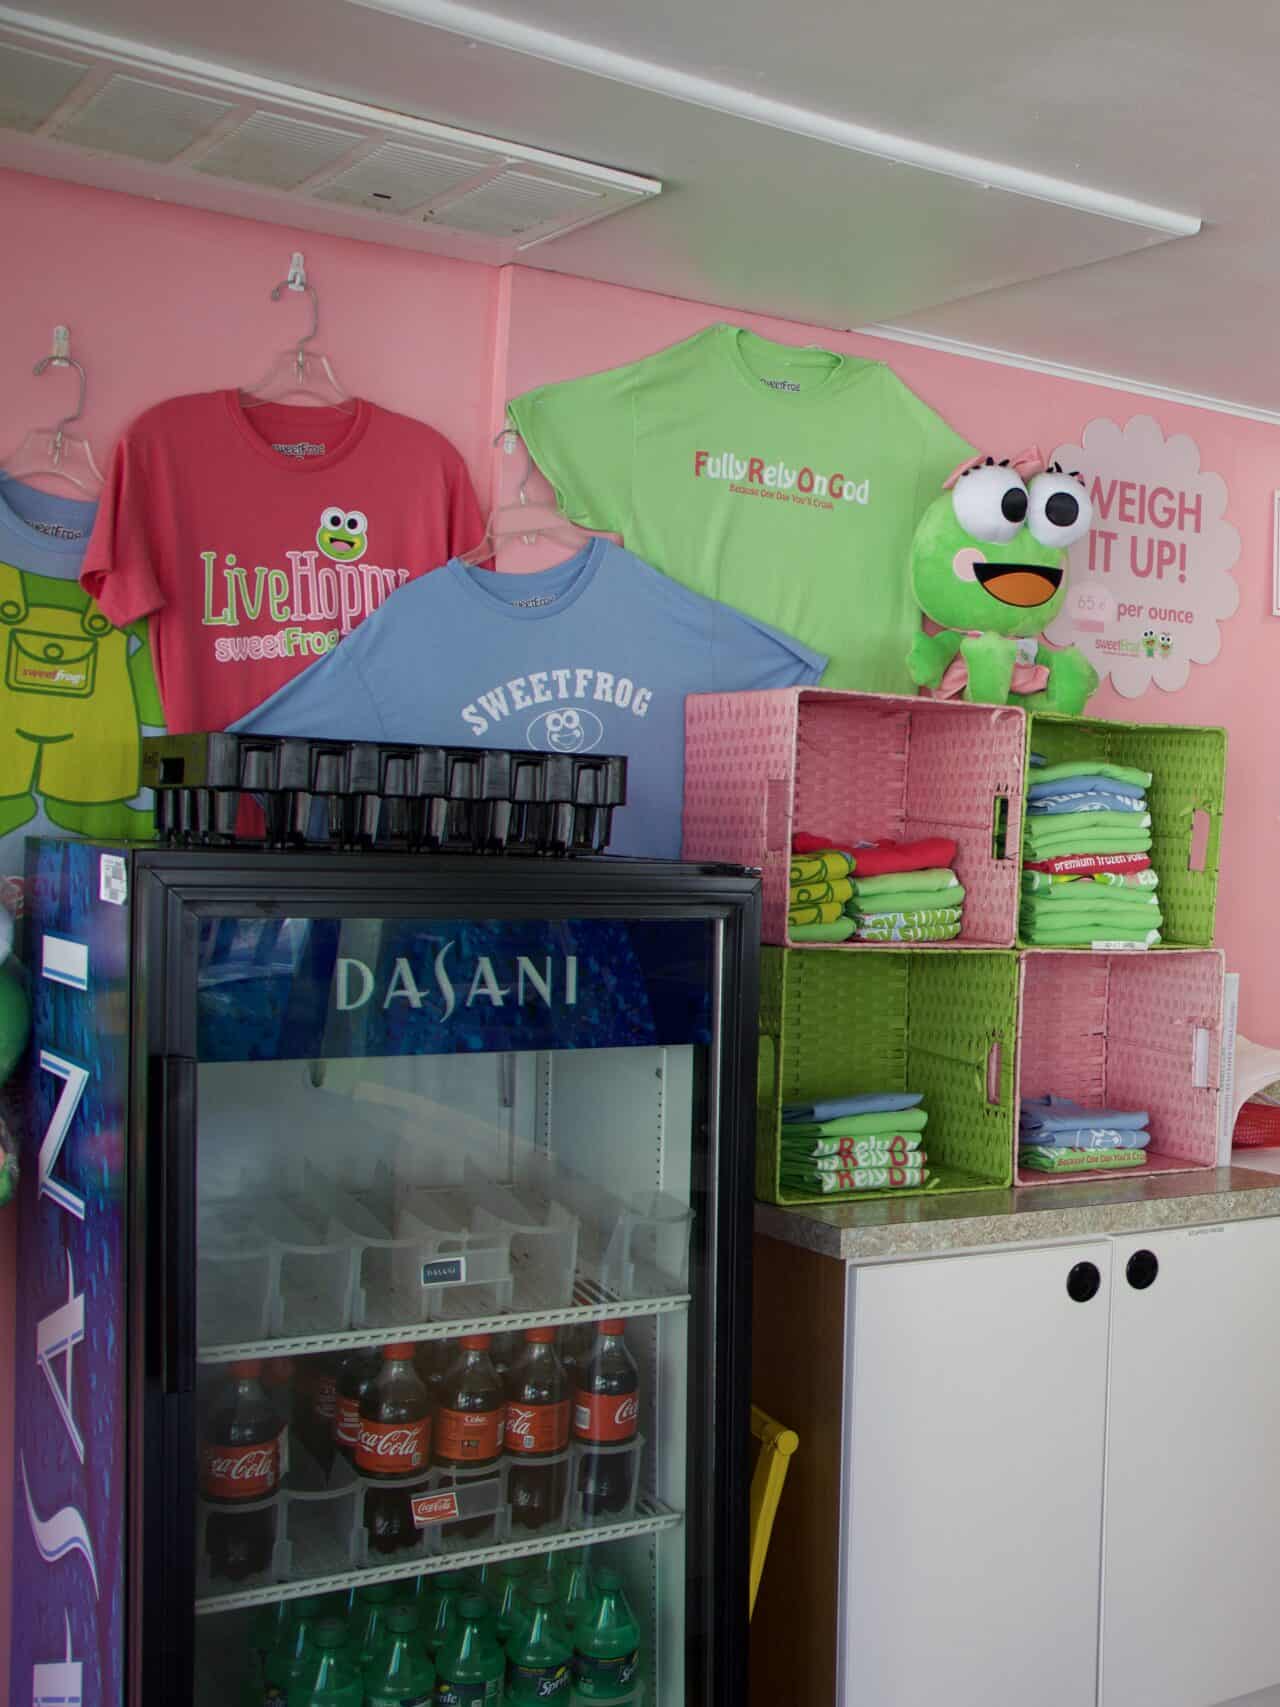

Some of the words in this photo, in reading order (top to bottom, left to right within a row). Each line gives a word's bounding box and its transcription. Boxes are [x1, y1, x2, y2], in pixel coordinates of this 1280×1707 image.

[1077, 474, 1202, 534] WEIGH
[1088, 529, 1118, 574] IT
[1130, 536, 1188, 584] UP!
[1117, 602, 1144, 622] per
[1148, 606, 1194, 625] ounce
[461, 667, 653, 737] SWEETFROG
[1054, 857, 1095, 873] premium
[336, 939, 577, 1023] DASANI
